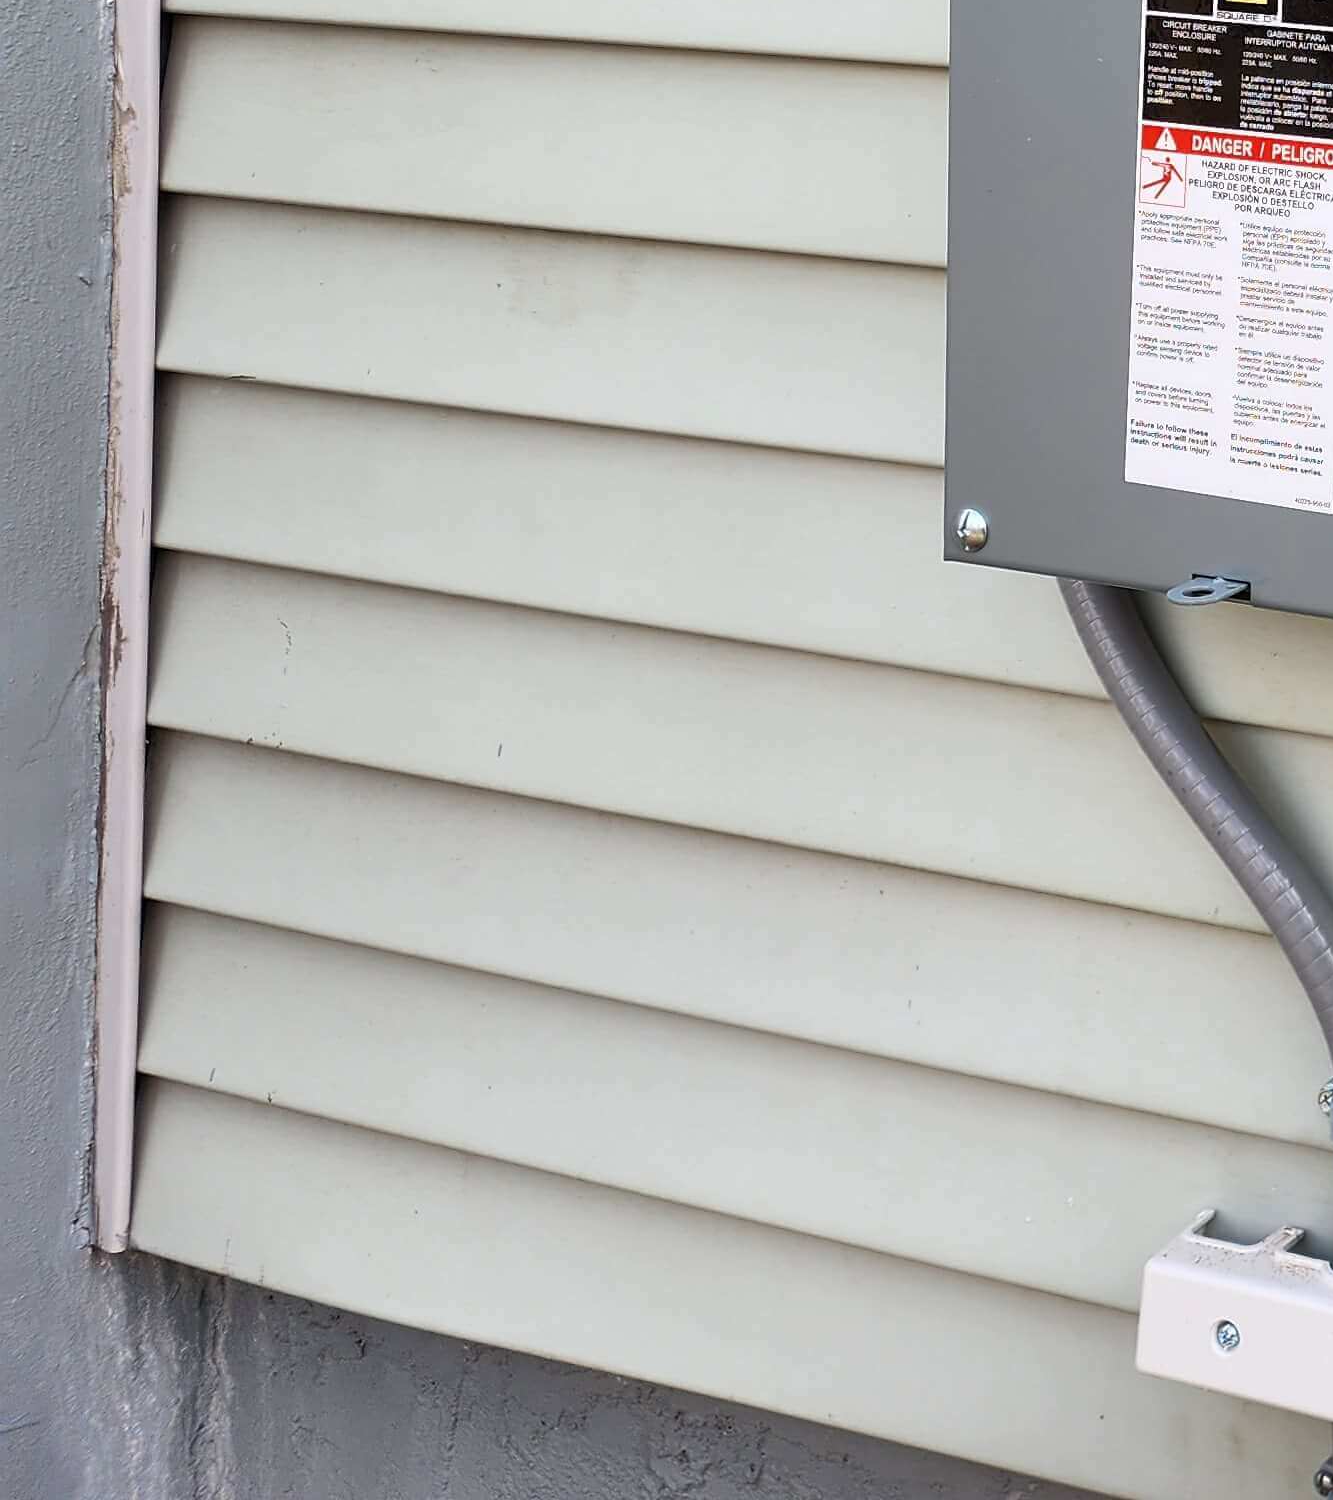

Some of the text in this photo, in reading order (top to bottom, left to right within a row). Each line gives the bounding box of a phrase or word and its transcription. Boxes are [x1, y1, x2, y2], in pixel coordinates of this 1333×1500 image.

[1217, 12, 1258, 21] SQUARE
[1162, 20, 1227, 33] CIRCUIT BREAKER
[1172, 30, 1217, 41] ENCLOSURE
[1266, 29, 1326, 42] GABINETE PARA
[1244, 36, 1297, 49] INTERRUPTOR
[1192, 135, 1253, 157] DANGER
[1201, 160, 1327, 182] HAZARD OF ELECTRIC SHOCK,
[1188, 178, 1224, 190] PELIGRO
[1227, 182, 1238, 191] DE
[1240, 184, 1287, 197] DESCARGA
[1259, 177, 1271, 185] OR
[1273, 178, 1291, 187] ARC
[1293, 180, 1321, 190] FLASH
[1262, 197, 1268, 205] O
[1271, 198, 1314, 210] DESTELLO
[1234, 203, 1291, 218] POR ARQUEO
[1166, 424, 1187, 433] follow
